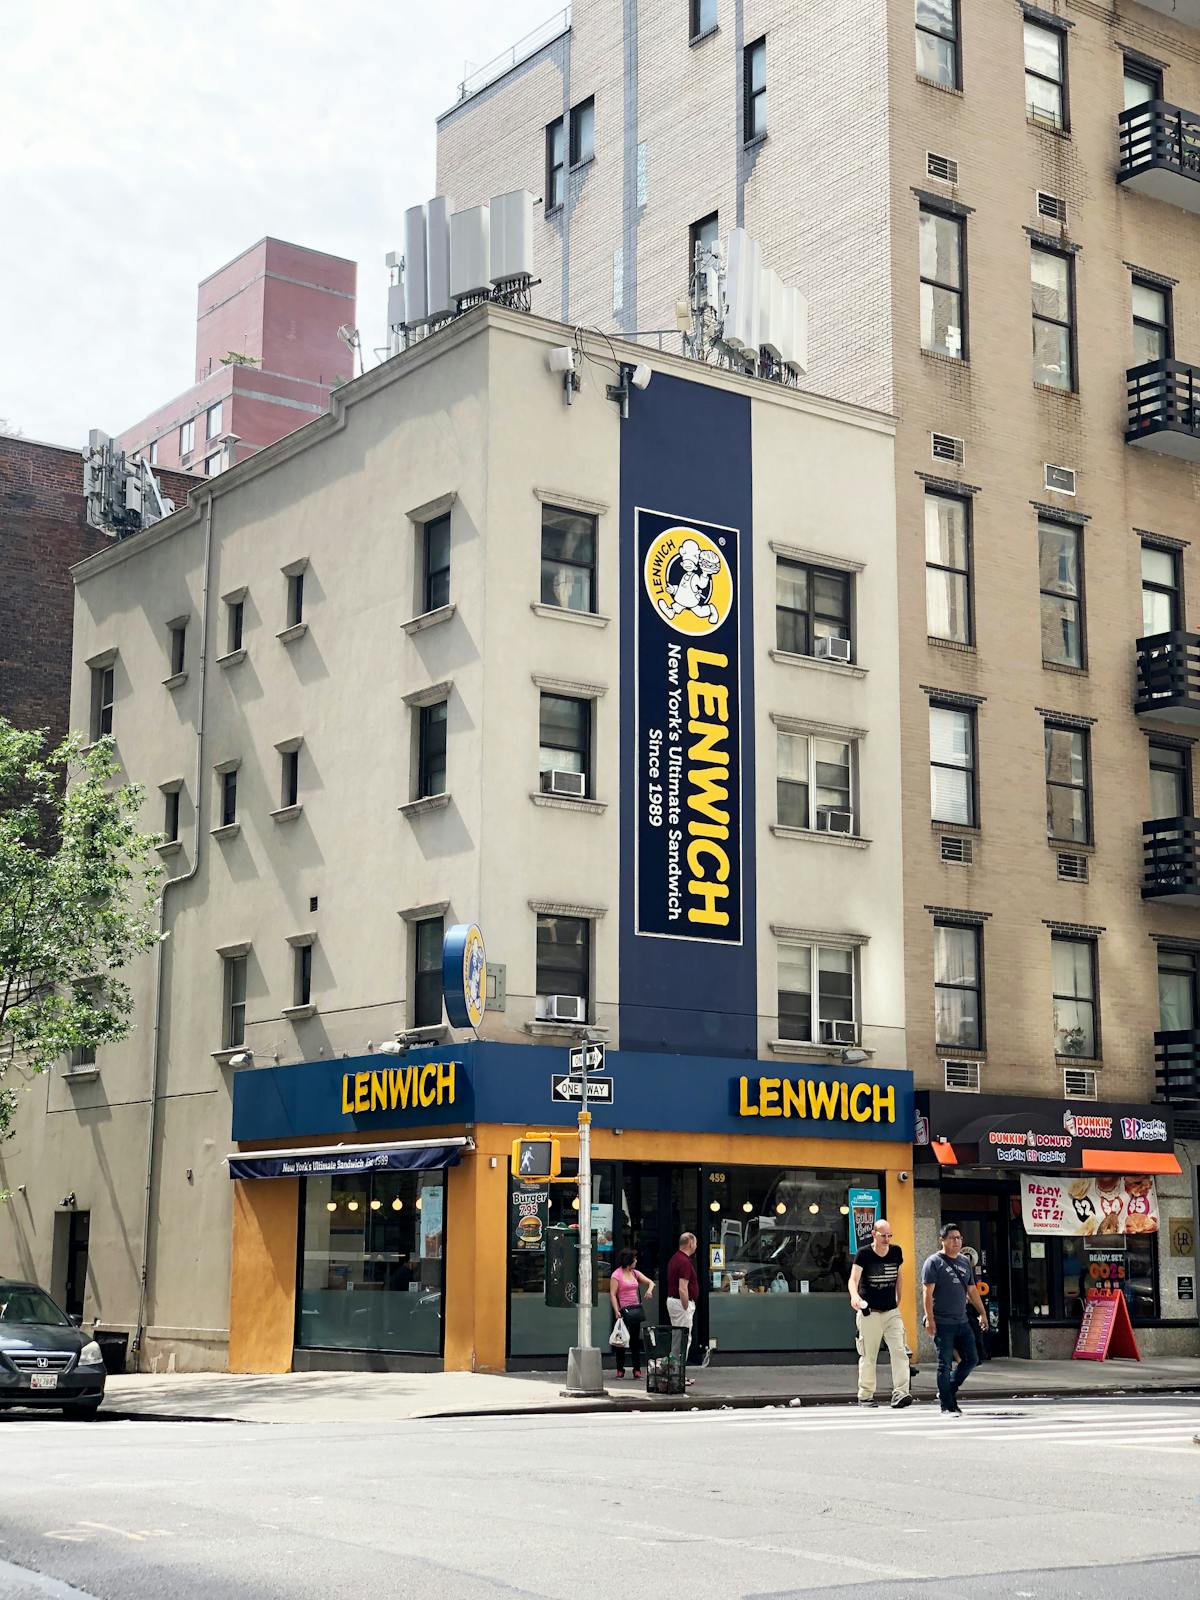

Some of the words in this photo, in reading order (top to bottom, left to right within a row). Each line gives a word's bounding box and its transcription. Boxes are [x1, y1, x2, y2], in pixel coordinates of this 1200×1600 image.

[652, 539, 676, 595] LENWICH
[667, 642, 682, 685] New
[668, 688, 682, 741] York's
[648, 728, 663, 778] Since
[668, 747, 682, 825] Ultimate
[687, 647, 730, 926] LENWICH
[648, 782, 663, 827] 1989
[668, 829, 682, 920] Sandwich
[341, 1061, 456, 1114] LENWICH
[561, 1083, 579, 1093] ONE
[587, 1084, 604, 1094] WAY
[739, 1076, 895, 1124] LENWICH
[1077, 1116, 1112, 1127] DUNKIN'
[1120, 1118, 1141, 1139] BR
[989, 1132, 1027, 1144] DUNKIN'
[1037, 1136, 1072, 1147] DONUTS
[1077, 1127, 1112, 1138] DONUTS
[997, 1148, 1026, 1162] baskin
[282, 1162, 295, 1172] New
[337, 1158, 364, 1169] Sandwich
[709, 1173, 726, 1183] 459
[512, 1192, 547, 1205] Burger
[1035, 1197, 1059, 1208] SET.
[1130, 1198, 1146, 1214] $5
[1032, 1209, 1050, 1219] GET
[1052, 1210, 1064, 1220] 2!
[1075, 1200, 1091, 1216] $2
[713, 1251, 722, 1263] A
